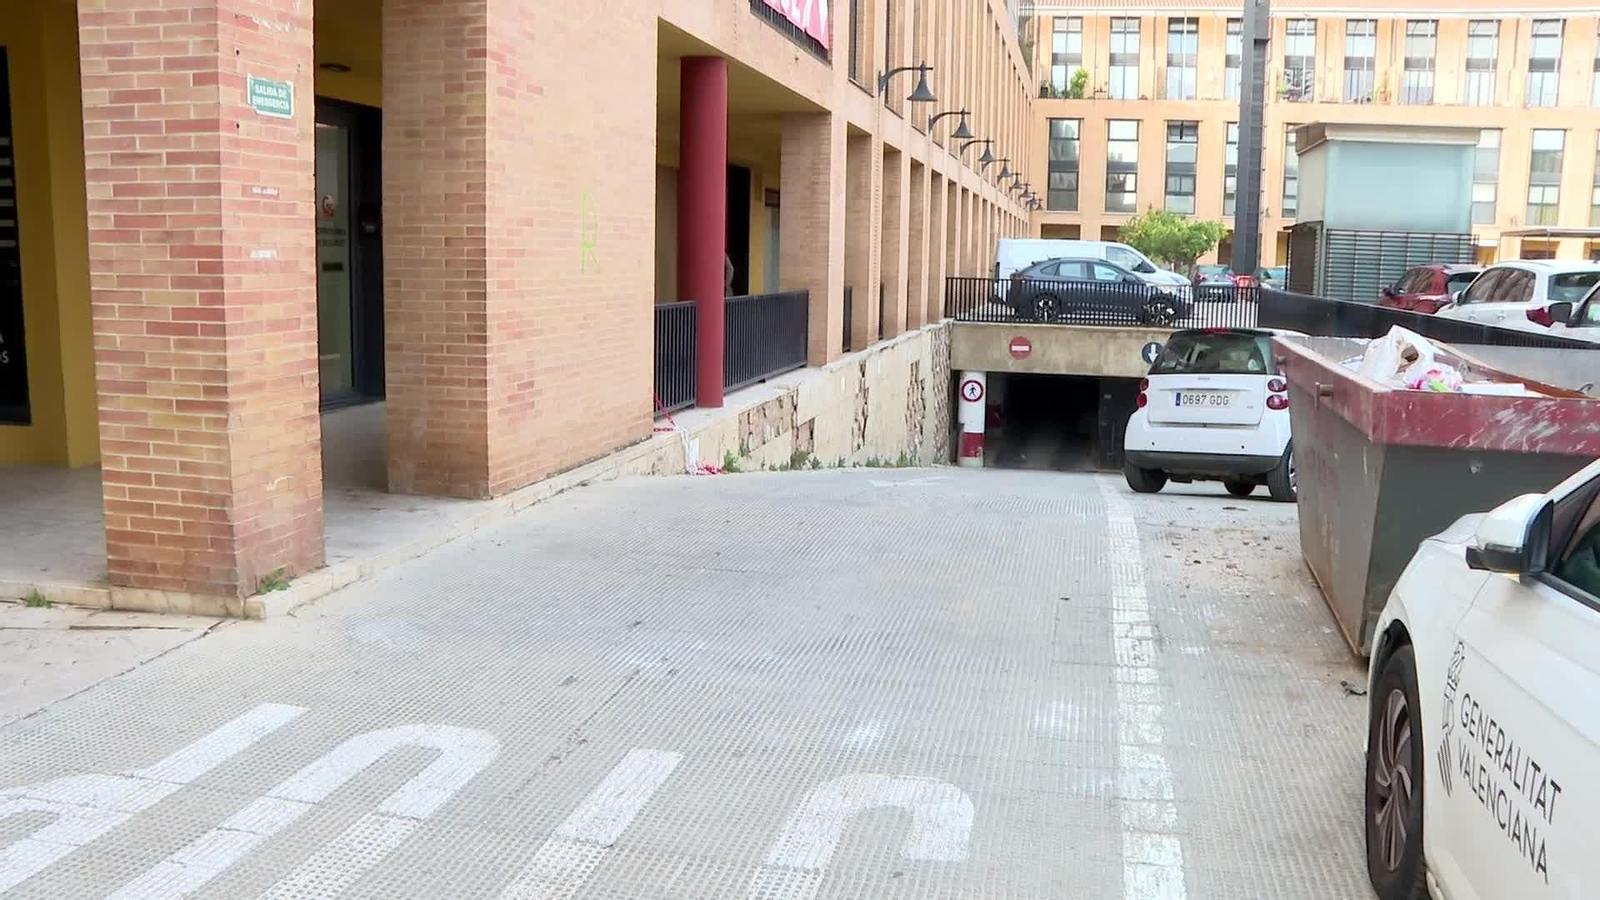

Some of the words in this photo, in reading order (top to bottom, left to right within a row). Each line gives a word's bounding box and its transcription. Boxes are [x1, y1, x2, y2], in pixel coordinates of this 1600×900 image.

[255, 84, 278, 96] SALIDA
[278, 87, 288, 99] DE
[252, 95, 289, 109] EMERGENCIA
[1182, 394, 1207, 405] 0697
[1209, 395, 1230, 406] GDG
[1460, 693, 1562, 825] GENERALITAT
[1458, 736, 1549, 886] VALENCIANA
